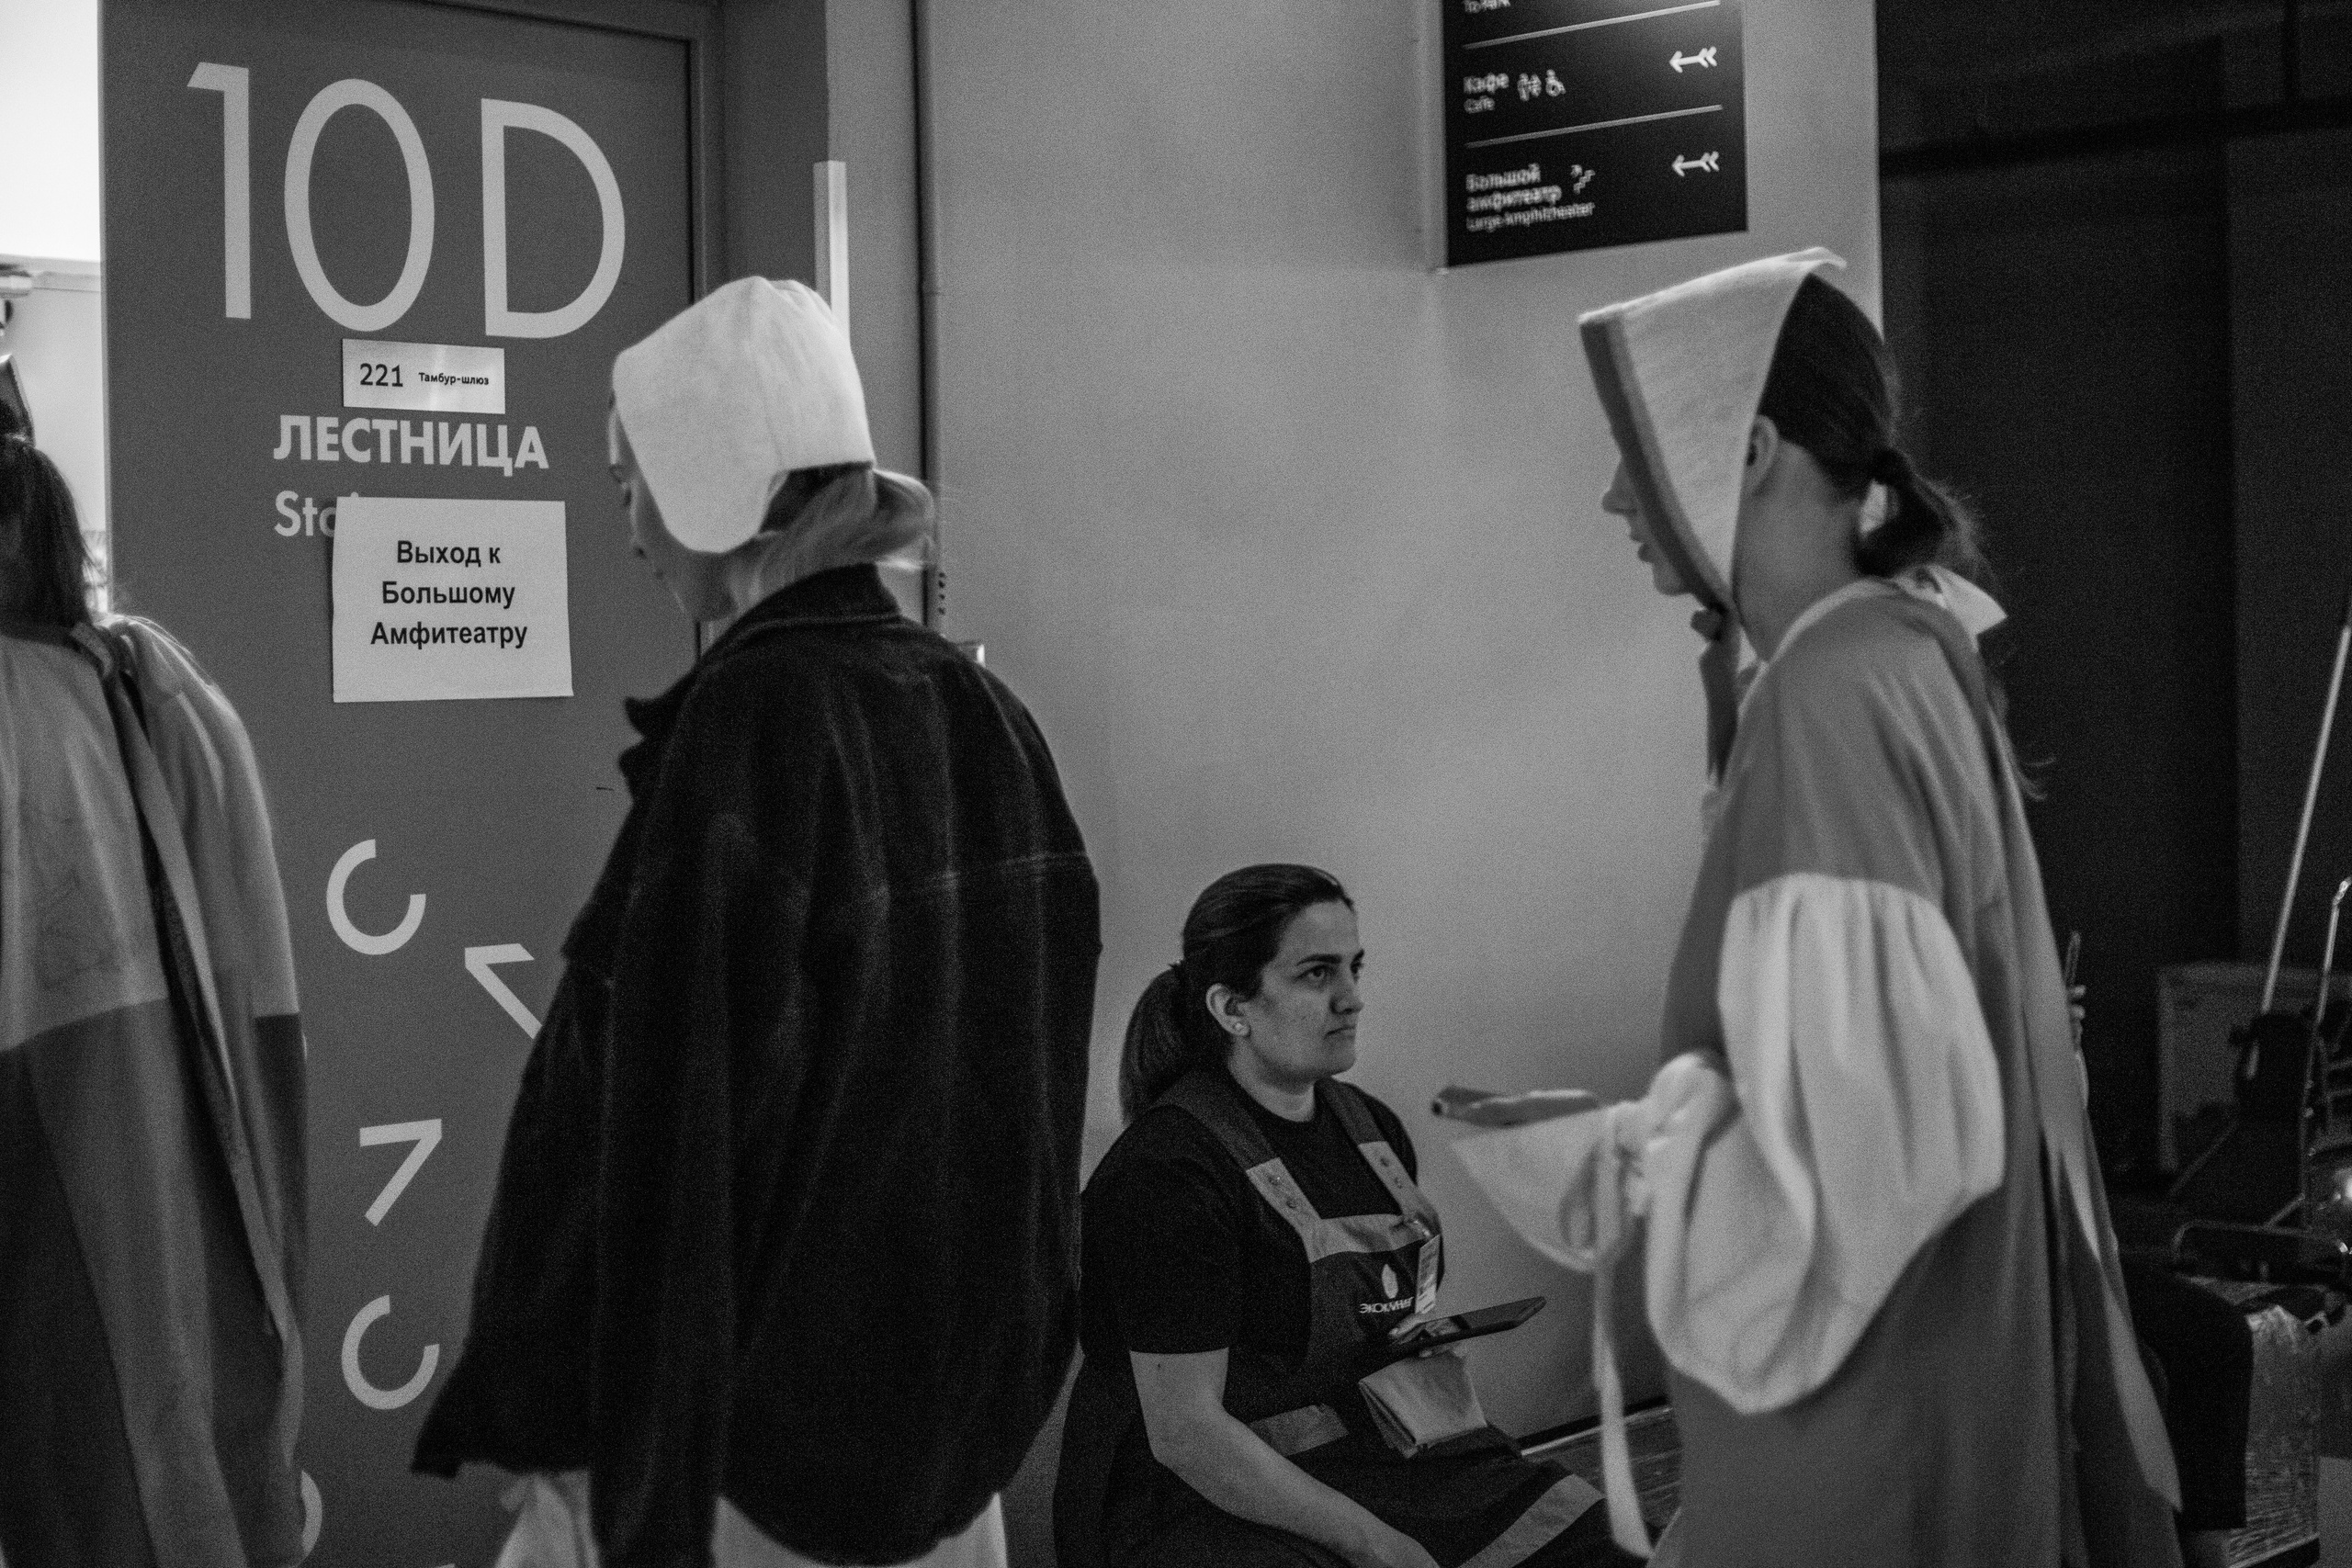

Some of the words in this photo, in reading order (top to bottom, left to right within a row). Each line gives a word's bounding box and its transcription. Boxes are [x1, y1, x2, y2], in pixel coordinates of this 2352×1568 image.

[1464, 73, 1510, 94] Кафе
[1465, 163, 1541, 193] Большой
[360, 363, 403, 387] 221
[418, 372, 490, 385] Тамбур-шлюз
[274, 414, 549, 477] ЛЕСТНИЦА
[397, 540, 481, 568] Выход
[490, 545, 501, 564] к
[382, 581, 515, 609] Большому
[370, 622, 528, 649] Амфитеатру
